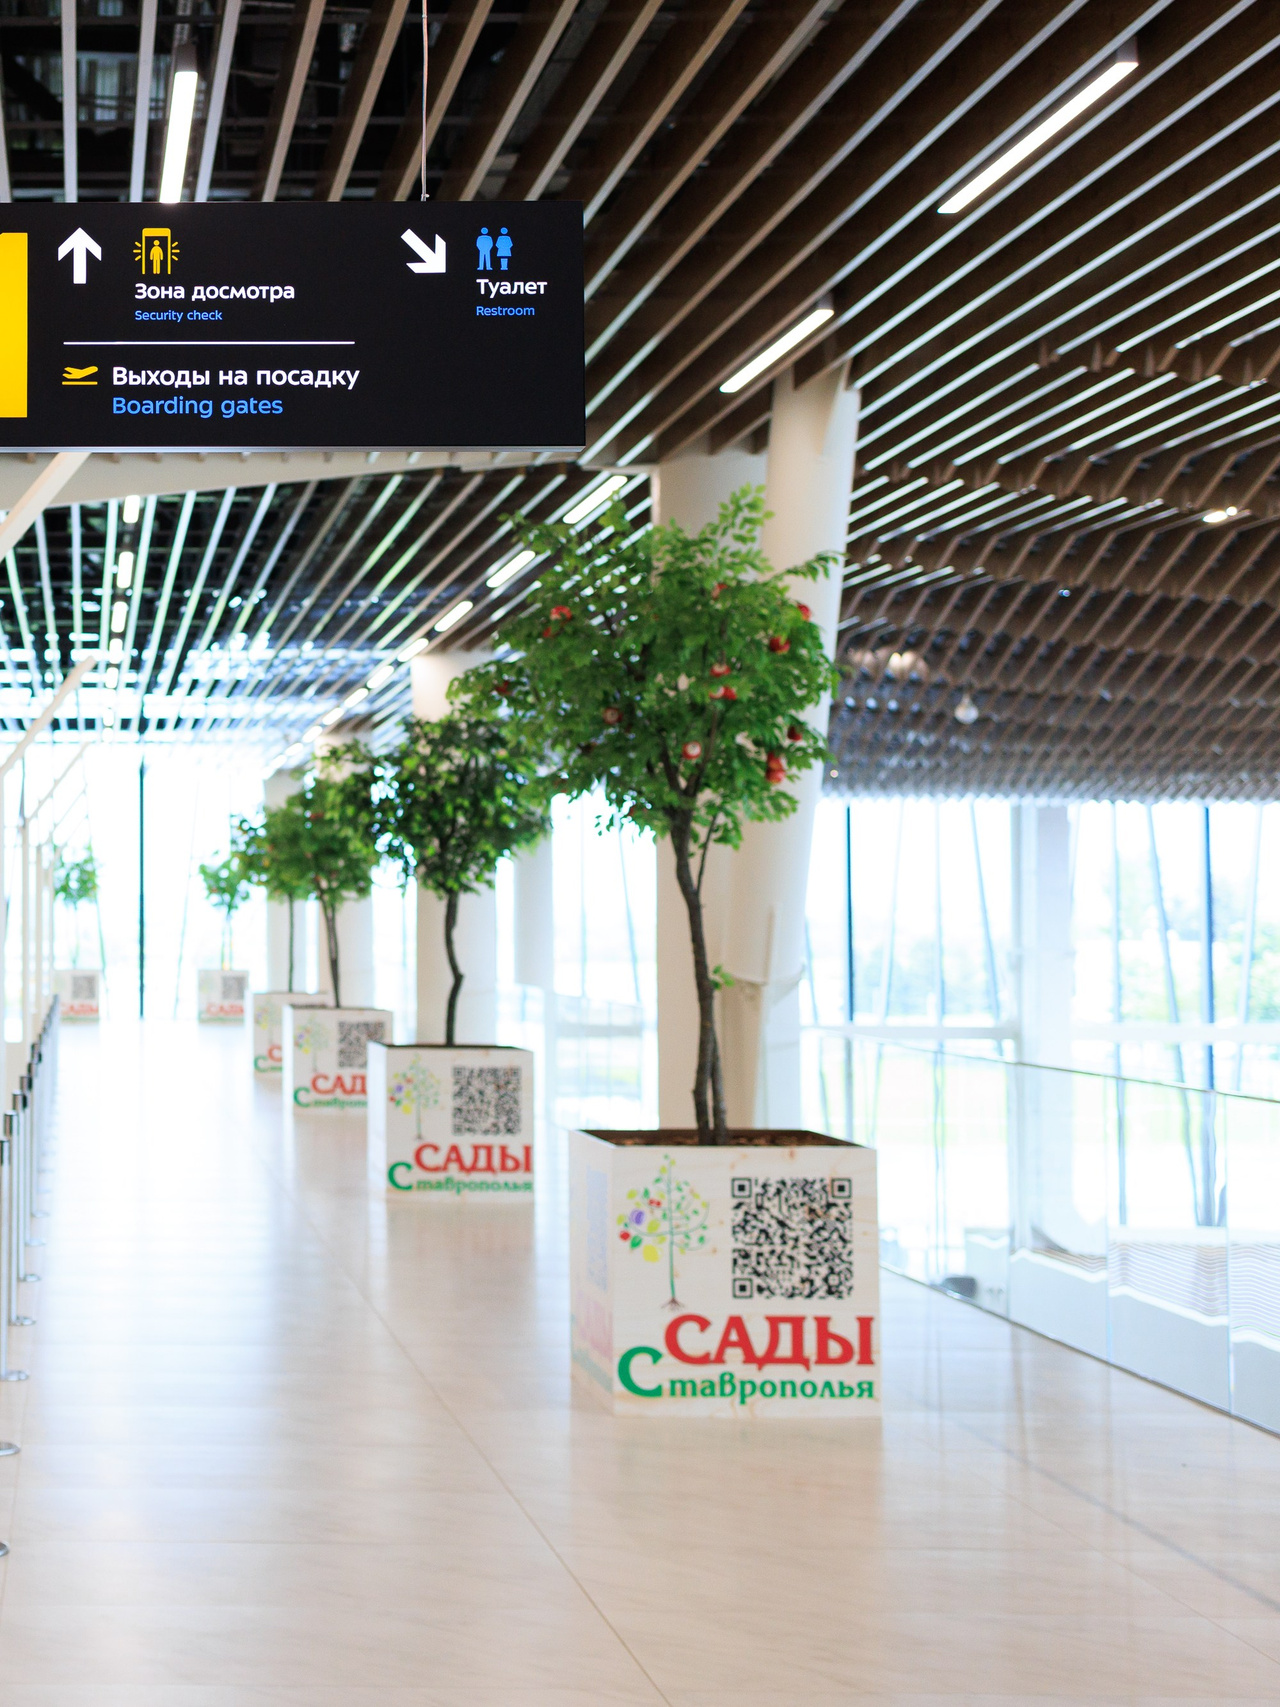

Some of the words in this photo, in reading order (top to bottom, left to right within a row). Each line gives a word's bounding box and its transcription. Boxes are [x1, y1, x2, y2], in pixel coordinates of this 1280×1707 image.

[134, 283, 185, 299] Зона
[191, 285, 295, 303] досмотра
[476, 279, 548, 298] Туалет
[134, 309, 184, 323] Security
[187, 309, 223, 321] check
[476, 305, 535, 317] Restroom
[112, 367, 211, 389] Выходы
[218, 370, 248, 386] на
[256, 370, 361, 391] посадку
[112, 396, 214, 419] Boarding
[220, 397, 284, 419] gates
[311, 1073, 366, 1095] САД
[414, 1143, 533, 1175] САДЫ
[387, 1161, 533, 1195] Ставрополья
[664, 1313, 874, 1370] САДЫ
[617, 1346, 875, 1406] Ставрополья
